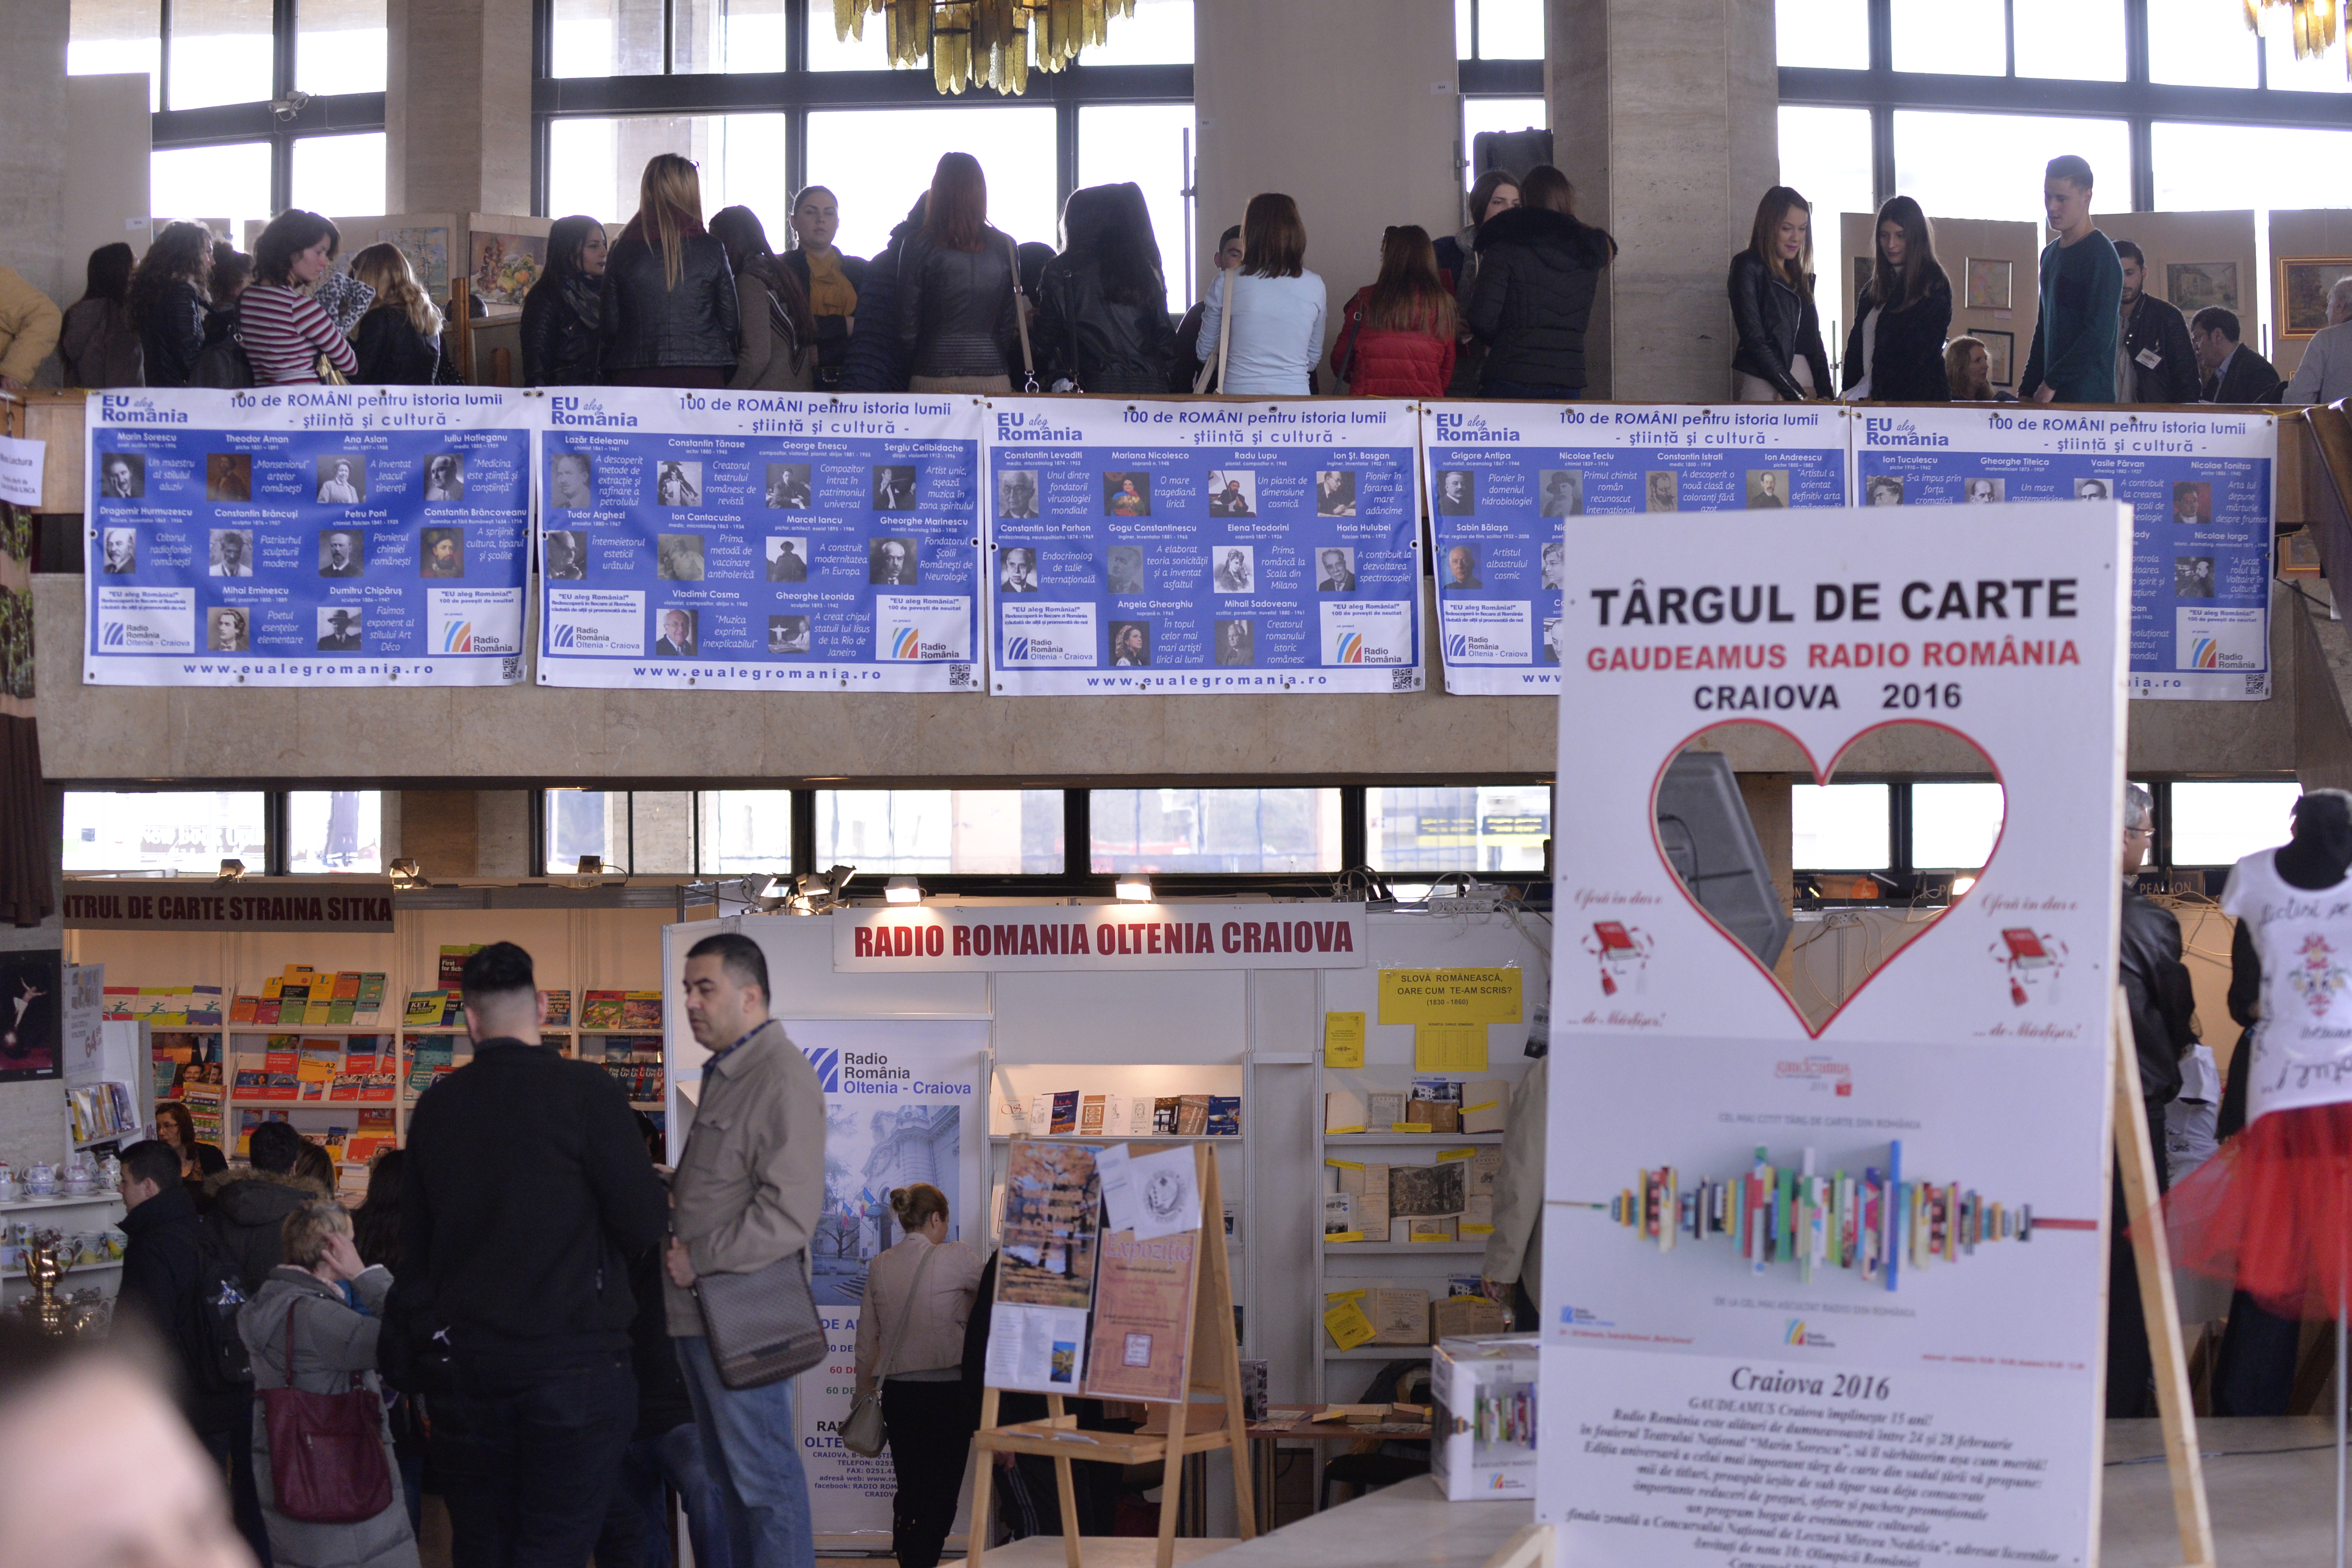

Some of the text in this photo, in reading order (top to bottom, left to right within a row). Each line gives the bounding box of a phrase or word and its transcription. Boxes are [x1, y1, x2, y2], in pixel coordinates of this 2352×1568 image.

[103, 395, 129, 407] EU
[231, 393, 502, 408] 100 de ROMÂNI pentru istoria lumii
[552, 398, 604, 413] EU aleg
[680, 397, 951, 415] 100 de ROMÂNI pentru istoria lumii
[102, 408, 188, 422] România
[382, 413, 446, 425] cultură
[552, 411, 638, 427] România
[998, 412, 1048, 430] EU aleg
[1123, 410, 1386, 425] 100 de ROMÂNI pentru istoria lumii
[1437, 413, 1486, 431] EU aleg
[1560, 411, 1818, 427] 100 de ROMÂNI pentru istoria lumii
[831, 420, 895, 434] cultură
[1866, 418, 1916, 434] EU aleg
[1988, 418, 2246, 435] 100 de ROMÂNI pentru istoria lumii
[998, 427, 1082, 440] România
[1271, 430, 1332, 443] cultură
[1437, 427, 1520, 442] România
[1705, 432, 1765, 444] cultură
[1866, 432, 1949, 446] România
[783, 442, 814, 451] George
[2133, 439, 2192, 452] cultură
[1485, 452, 1511, 460] Antipa
[1271, 476, 1294, 486] pianist
[1489, 474, 1515, 482] Pionier
[1261, 488, 1304, 496] dimensiune
[1489, 485, 1524, 494] domeniul
[1268, 500, 1299, 508] cosmică
[1482, 497, 1532, 506] hidrobiologiei
[787, 516, 815, 524] Marcel
[223, 586, 289, 595] Mihai Eminescu
[1592, 579, 2078, 627] TÂRGUL DE CARTE
[1588, 635, 2080, 671] GAUDEAMUS RADIO ROMÂNIA
[183, 663, 434, 677] www.eualegromania.ro
[634, 666, 881, 681] www.eualegromania.ro
[1087, 673, 1327, 688] www.eualegromania.ro
[1695, 682, 1962, 710] CRAIOVA 2016
[2140, 882, 2191, 894] PEAON
[128, 896, 153, 918] DE
[159, 896, 224, 920] CARTE
[230, 897, 323, 921] STRAINA
[328, 897, 392, 922] SITKA
[855, 921, 1353, 957] RADIO ROMANIA OLTENIA CRAIOVA
[844, 1053, 887, 1064] Radio
[844, 1067, 910, 1079] România
[844, 1081, 971, 1095] Oltenia Craiova
[1732, 1366, 1890, 1400] Craiova 2016
